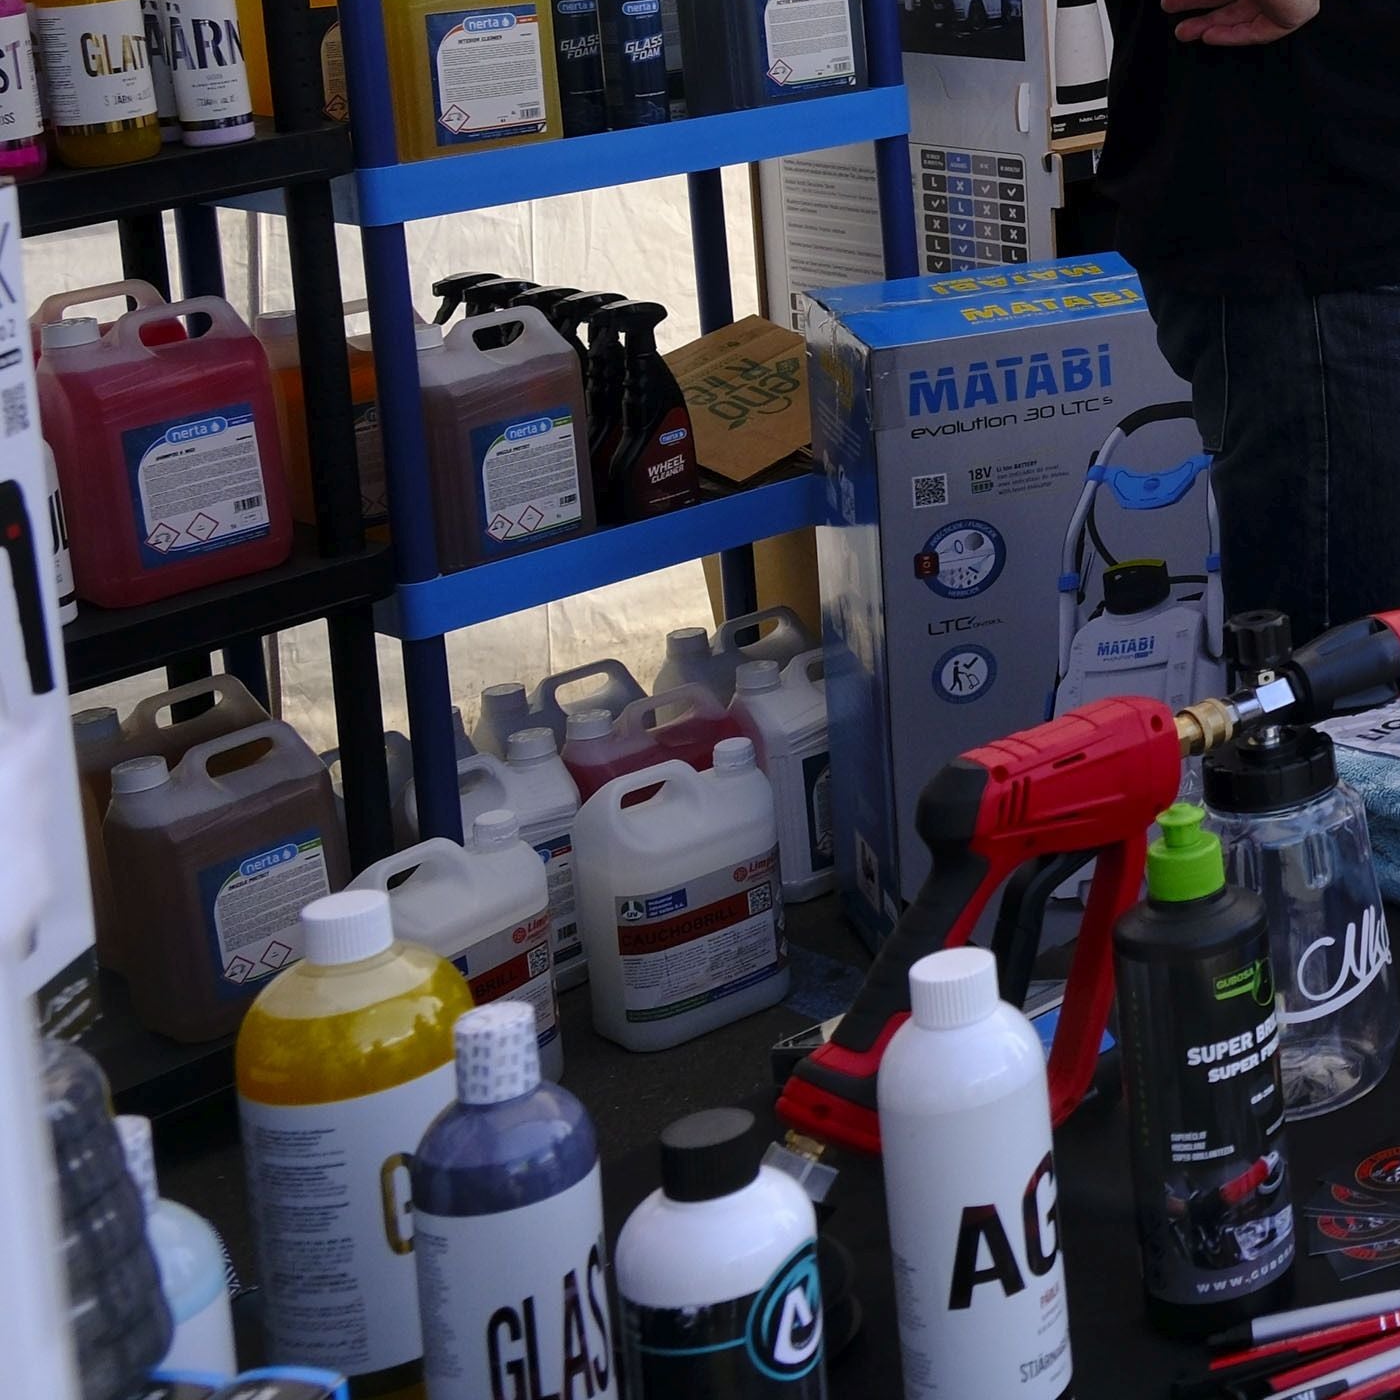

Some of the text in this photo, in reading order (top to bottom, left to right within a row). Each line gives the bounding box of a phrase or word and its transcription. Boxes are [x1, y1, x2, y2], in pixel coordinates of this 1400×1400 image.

[562, 1, 593, 13] nerta
[628, 1, 654, 13] nerta
[469, 19, 499, 33] nerta
[560, 34, 601, 52] GLASS
[624, 34, 664, 55] GLASS
[567, 47, 600, 62] FOAM
[632, 47, 662, 62] FOAM
[960, 289, 1141, 322] MATABI
[911, 413, 1018, 440] evolution
[1024, 405, 1055, 423] 30
[1062, 397, 1100, 416] LTC
[172, 424, 208, 442] nerta
[510, 424, 538, 440] nerta
[648, 454, 686, 478] WHEEL
[651, 464, 685, 484] CLEANER
[968, 465, 993, 482] 18V
[1097, 636, 1154, 657] MATABI
[247, 854, 280, 874] nerta
[1216, 966, 1256, 991] GUBOSA
[1187, 1030, 1254, 1068] SUPER
[1208, 1052, 1260, 1084] SUPER
[487, 1245, 613, 1400] GLAS
